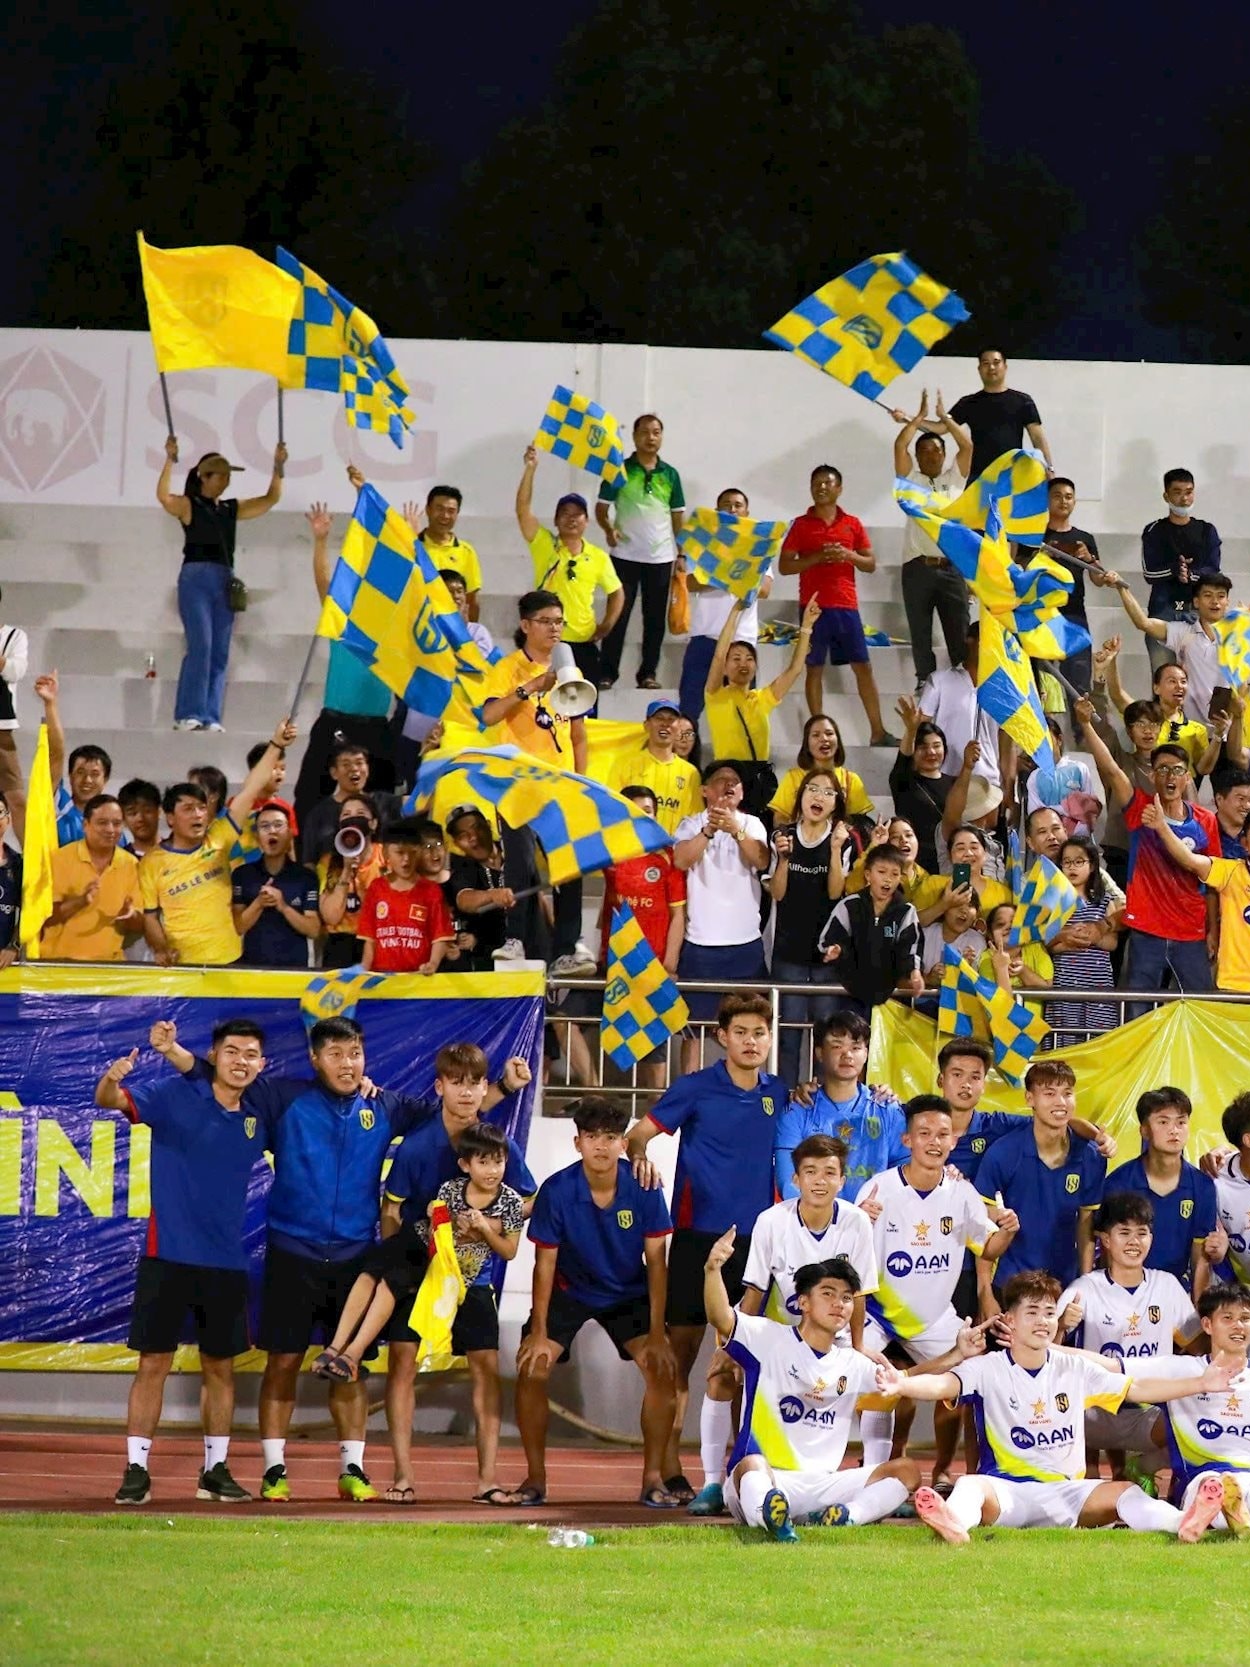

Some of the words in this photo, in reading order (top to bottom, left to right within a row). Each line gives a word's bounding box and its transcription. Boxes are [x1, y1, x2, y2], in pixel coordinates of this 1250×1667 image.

[640, 897, 654, 908] FC
[915, 1253, 949, 1269] AAN
[1126, 1341, 1158, 1358] AAN
[804, 1408, 836, 1425] AAN
[1037, 1425, 1074, 1446] AAN
